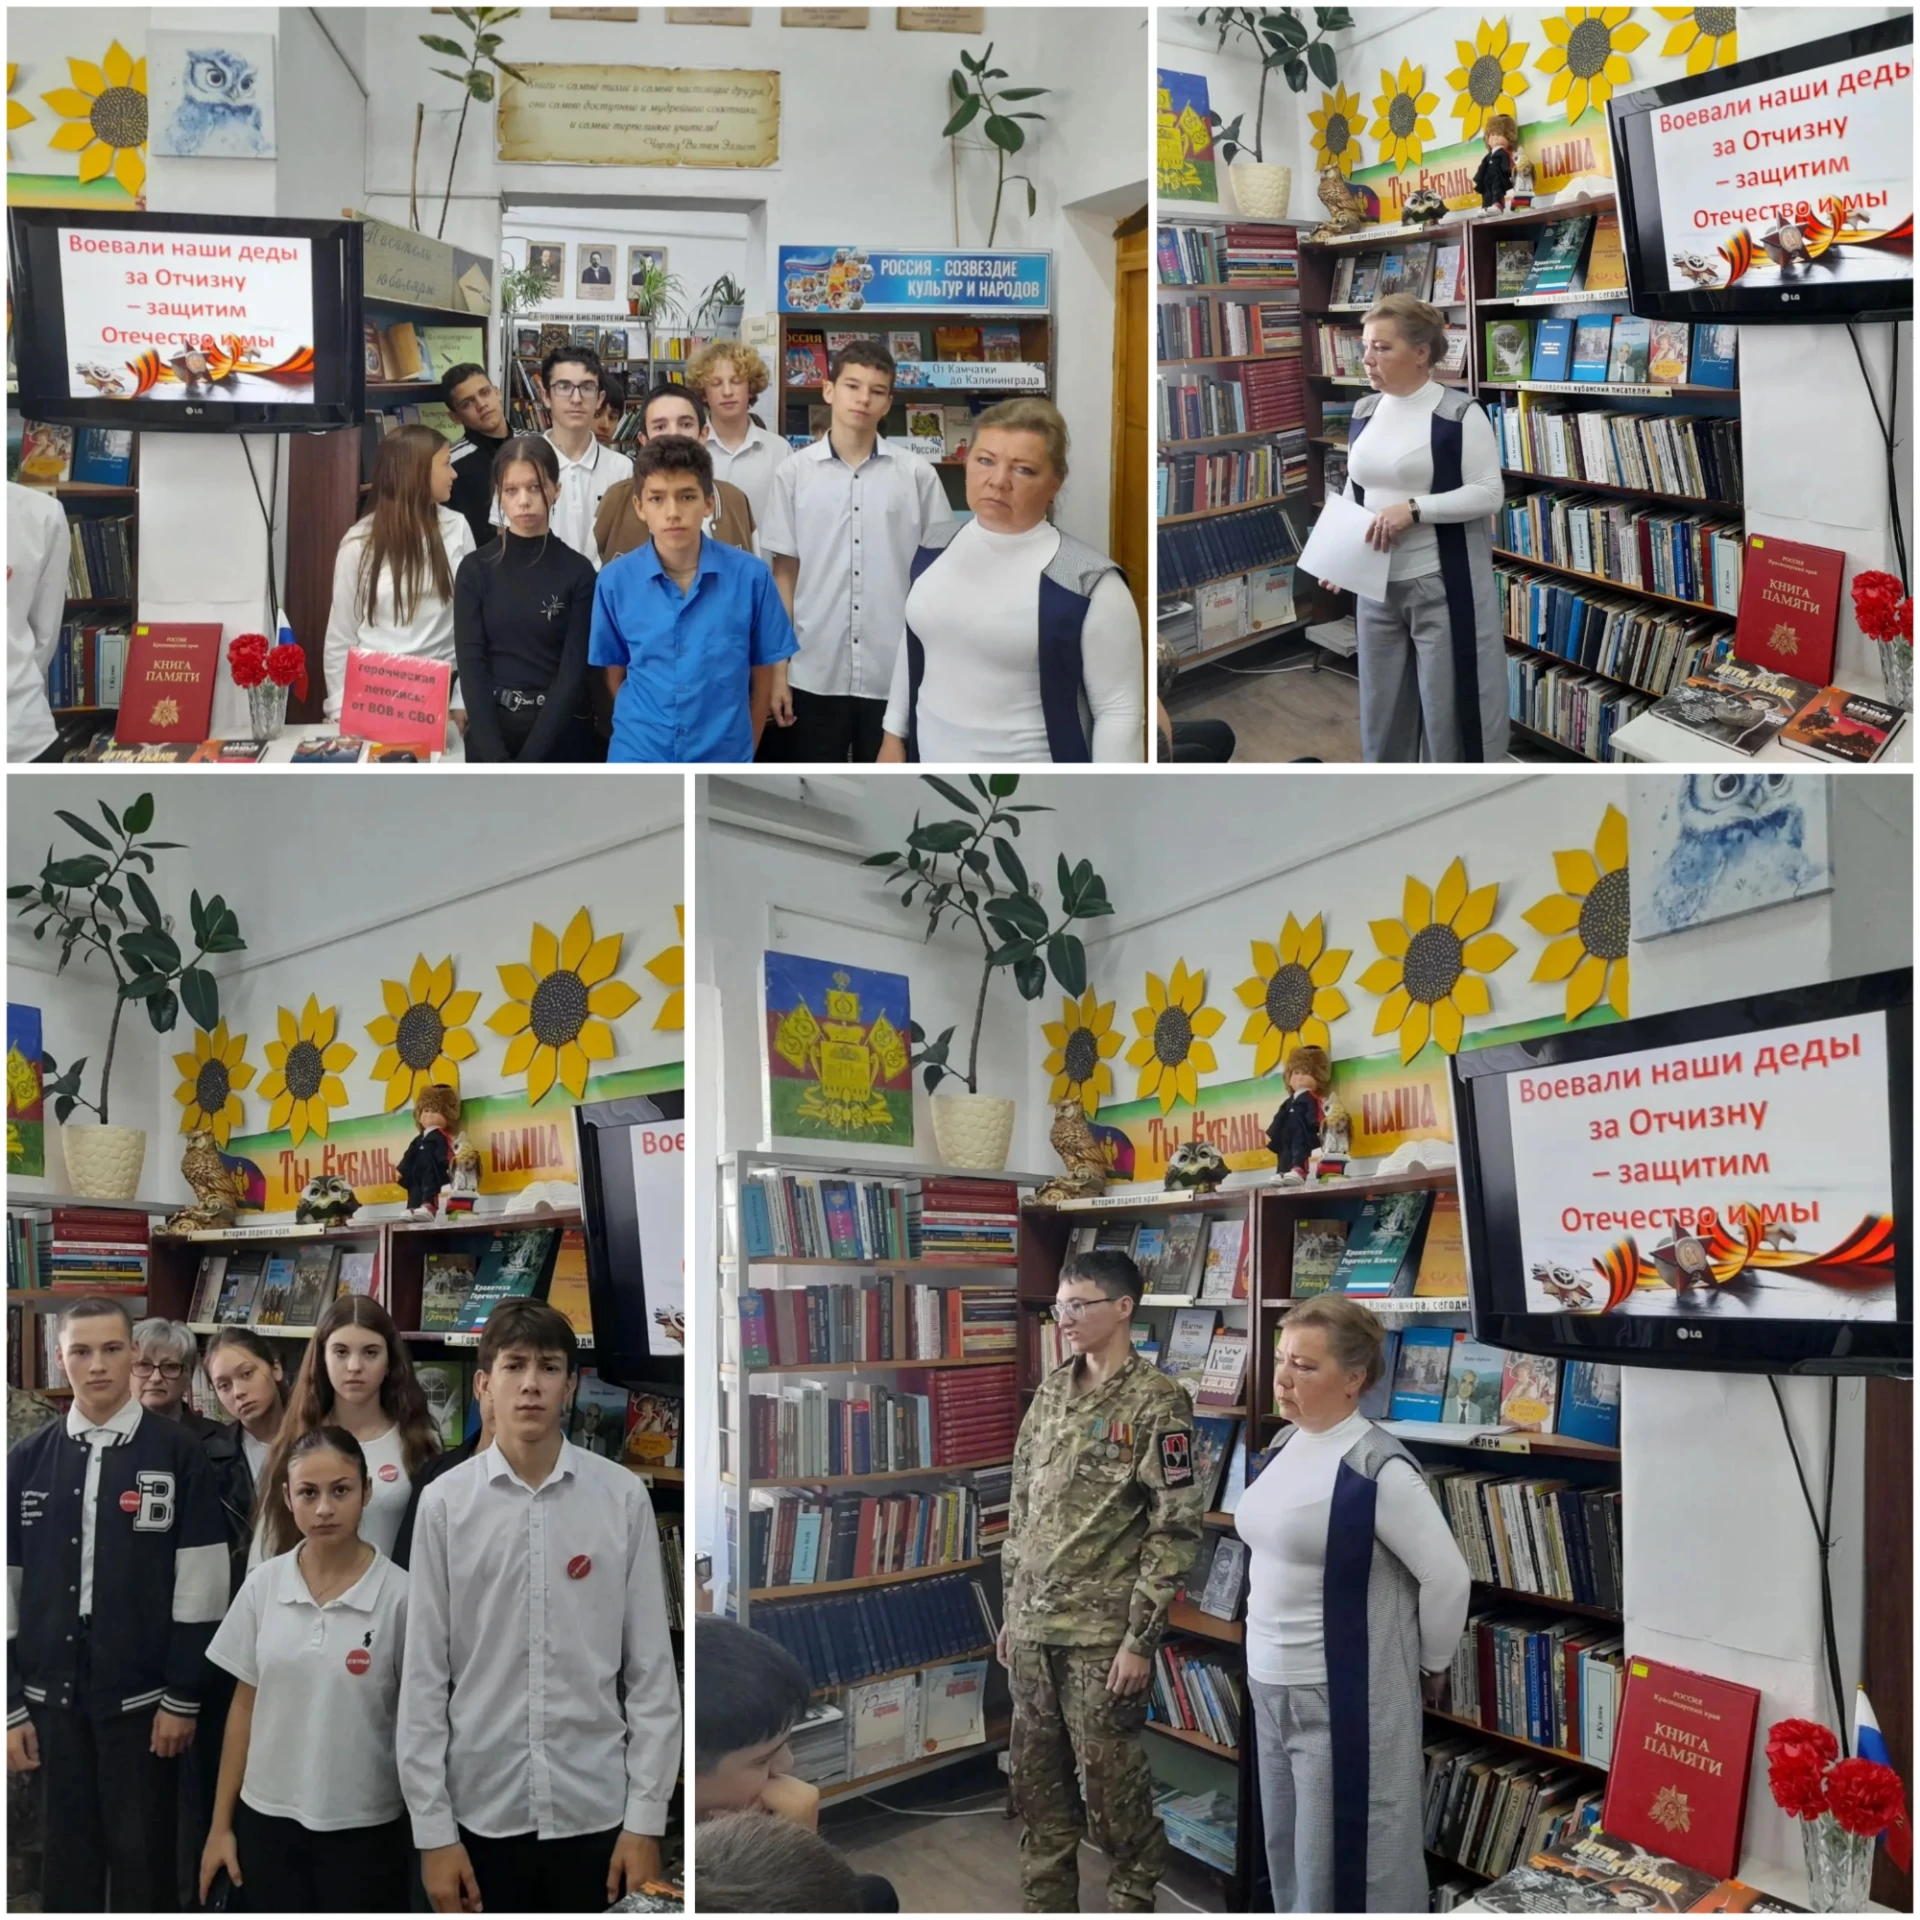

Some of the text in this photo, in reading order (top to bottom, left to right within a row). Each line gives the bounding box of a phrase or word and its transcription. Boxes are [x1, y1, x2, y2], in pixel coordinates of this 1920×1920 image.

[1659, 95, 1752, 134] Воевали
[1759, 79, 1829, 113] наши
[1712, 115, 1849, 159] за Отчизну
[1541, 137, 1597, 180] НАША
[1735, 155, 1850, 191] защитим
[1692, 188, 1888, 230] Отечество и мы
[69, 234, 299, 263] Воевали наши деды
[125, 268, 247, 293] за Отчизну
[880, 258, 932, 277] РОССИЯ
[944, 259, 1018, 279] СОЗВЕЗДИЕ
[907, 280, 1040, 300] КУЛЬТУР И НАРОДОВ
[146, 300, 247, 320] защитим
[101, 325, 275, 349] Отечество и мы
[931, 363, 998, 375] От Камчатки
[950, 375, 1041, 388] до Калининграда
[1611, 385, 1652, 396] писателей
[1761, 588, 1820, 616] ПАМЯТИ
[1769, 578, 1811, 599] КНИГА
[145, 670, 201, 683] ПАМЯТИ
[152, 659, 192, 671] КНИГА
[351, 700, 436, 726] от ВОВ к СВО
[1518, 1032, 1862, 1104] Воевали наши деды
[1362, 1083, 1438, 1137] НАША
[1589, 1098, 1768, 1142] за Отчизну
[490, 1123, 564, 1174] НАША
[1617, 1151, 1770, 1187] защитим
[1561, 1199, 1820, 1233] Отечество и мы
[461, 1335, 481, 1346] Горя
[1654, 1721, 1710, 1754] КНИГА
[1643, 1735, 1723, 1778] ПАМЯТИ
